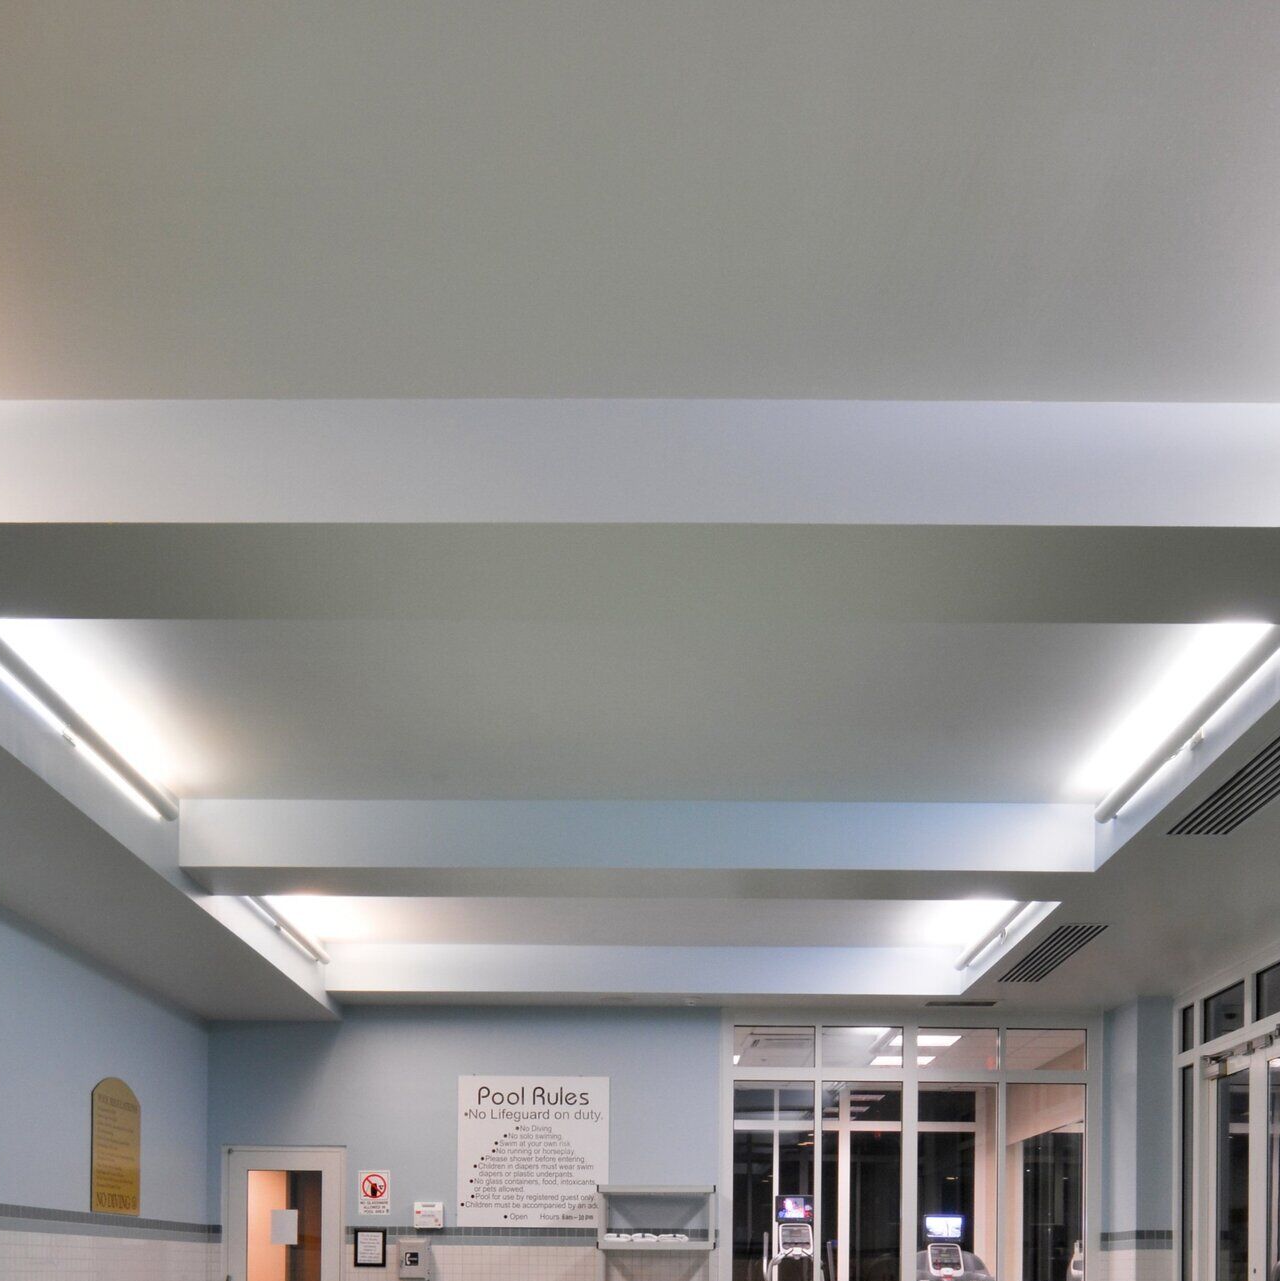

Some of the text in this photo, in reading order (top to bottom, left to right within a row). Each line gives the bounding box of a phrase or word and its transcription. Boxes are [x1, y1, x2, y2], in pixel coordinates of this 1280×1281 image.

[477, 1086, 590, 1106] Pool Rules
[468, 1108, 603, 1123] No Lifeguard on duty.
[531, 1125, 553, 1134] Diving
[507, 1148, 532, 1156] running
[478, 1162, 506, 1170] Children
[514, 1163, 539, 1171] diapers
[478, 1170, 503, 1178] diapers
[513, 1170, 535, 1178] plastic
[485, 1178, 503, 1187] glass
[482, 1186, 498, 1194] pets
[516, 1194, 525, 1202] by
[526, 1194, 559, 1202] registered
[560, 1194, 579, 1202] guest
[567, 1202, 576, 1210] by
[509, 1213, 528, 1221] Open
